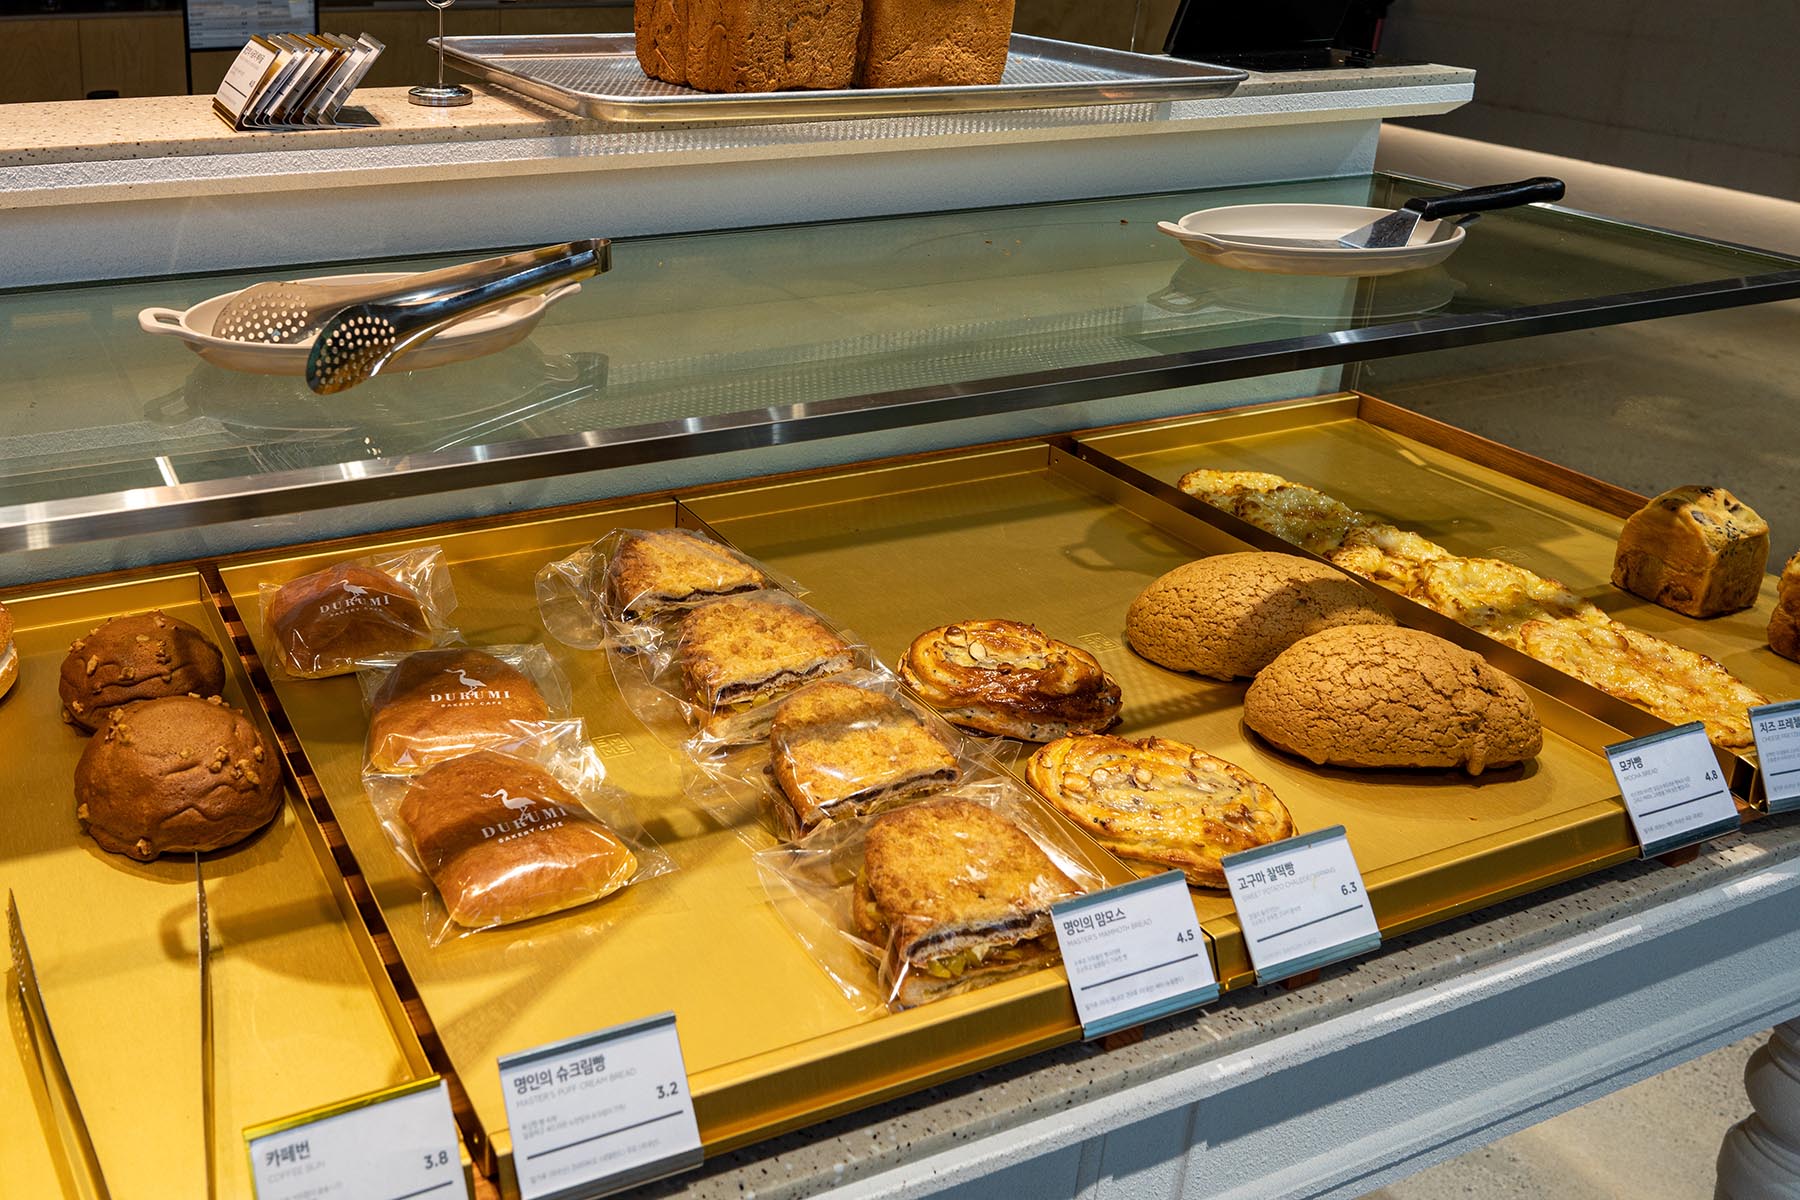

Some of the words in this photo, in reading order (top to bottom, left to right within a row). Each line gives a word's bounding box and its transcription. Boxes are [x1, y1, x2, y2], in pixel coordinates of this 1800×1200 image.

[320, 595, 390, 614] DURUMI
[430, 690, 510, 702] DURUMI
[1760, 721, 1777, 733] 치즈
[1619, 756, 1644, 772] 모카빵
[1705, 769, 1718, 782] 4.8
[481, 807, 568, 839] DURUMI
[498, 827, 535, 844] BAKERY
[539, 821, 564, 831] CAFE
[1237, 872, 1267, 891] 고구마
[1267, 861, 1296, 883] 찰떡빵
[1341, 881, 1358, 896] 6.3
[1063, 914, 1095, 936] 명인의
[1095, 907, 1126, 927] 맘모스
[1176, 929, 1194, 944] 4.5
[514, 1069, 553, 1095] 명인의
[556, 1054, 606, 1083] 슈크림빵
[656, 1081, 679, 1100] 3.2
[265, 1140, 311, 1168] 카페번
[424, 1150, 448, 1170] 3.8
